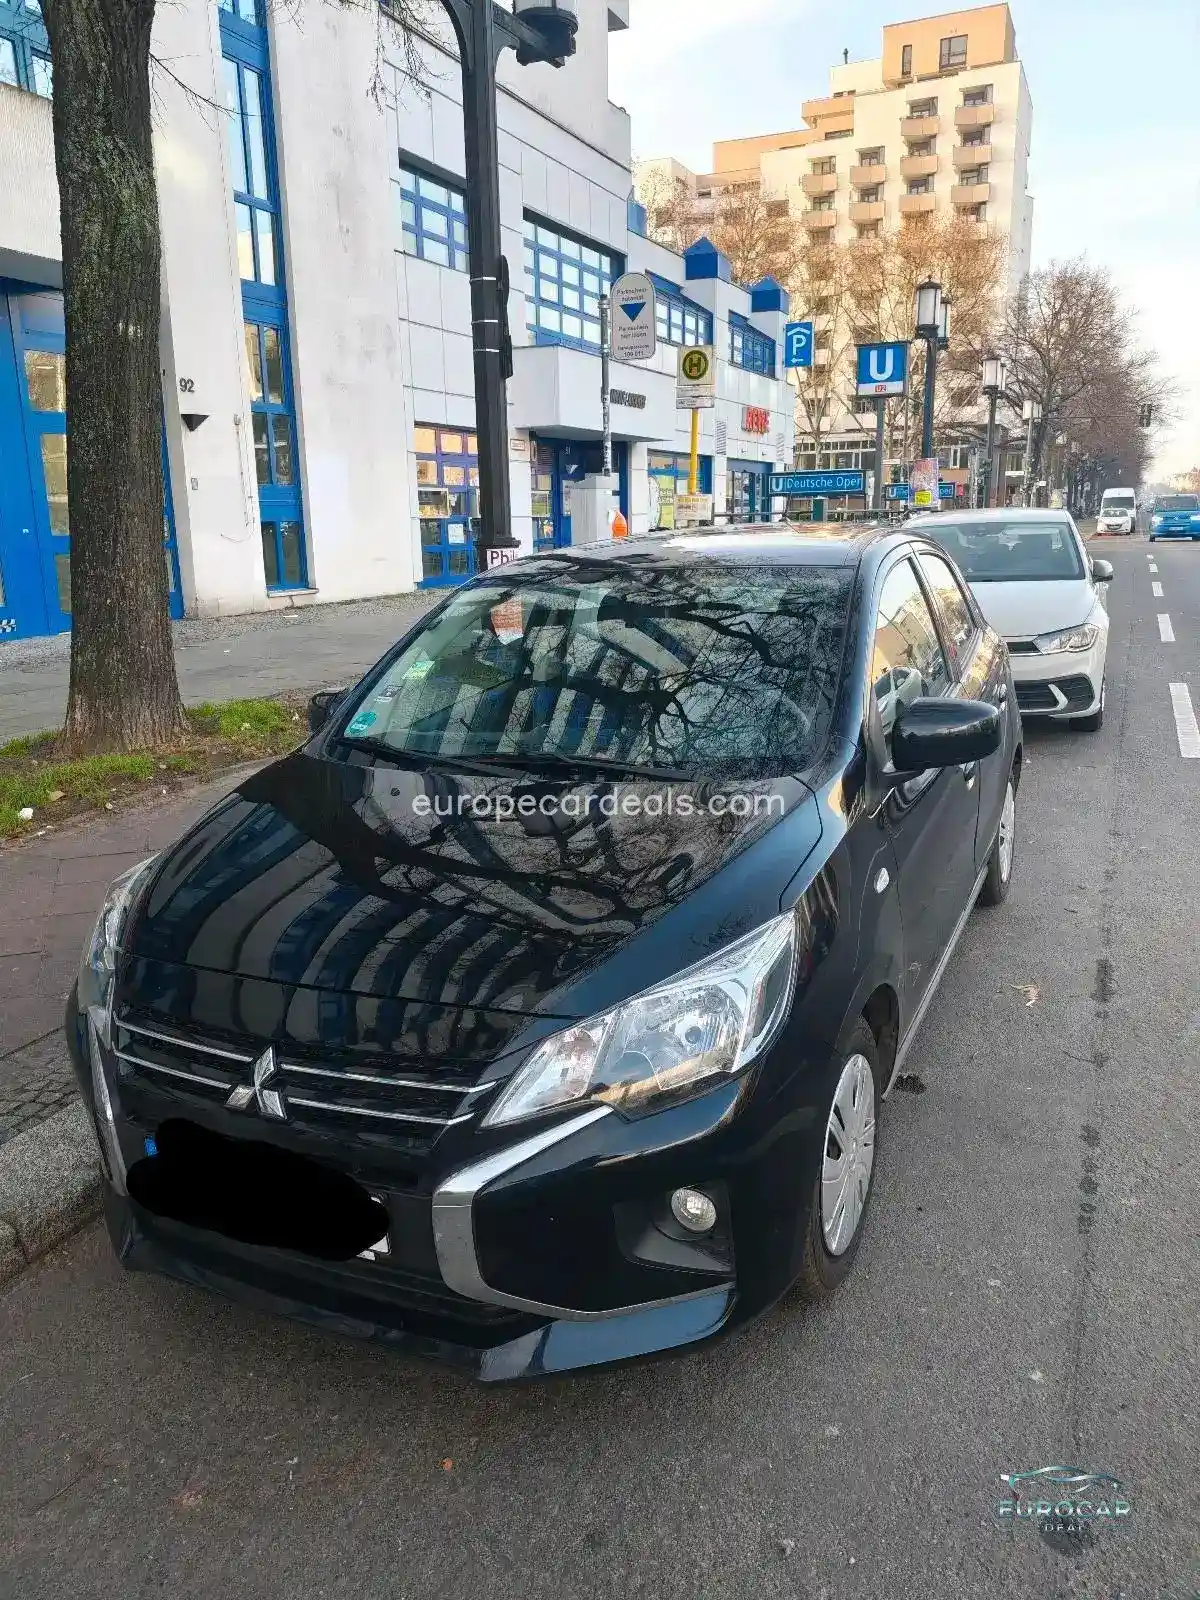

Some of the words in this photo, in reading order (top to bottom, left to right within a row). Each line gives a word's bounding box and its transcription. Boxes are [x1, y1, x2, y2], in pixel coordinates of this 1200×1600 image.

[793, 335, 806, 355] P
[689, 356, 702, 374] H
[870, 348, 894, 381] U
[179, 378, 195, 392] 92
[772, 477, 784, 492] U
[787, 477, 833, 489] Deutsche
[836, 476, 862, 490] Oper
